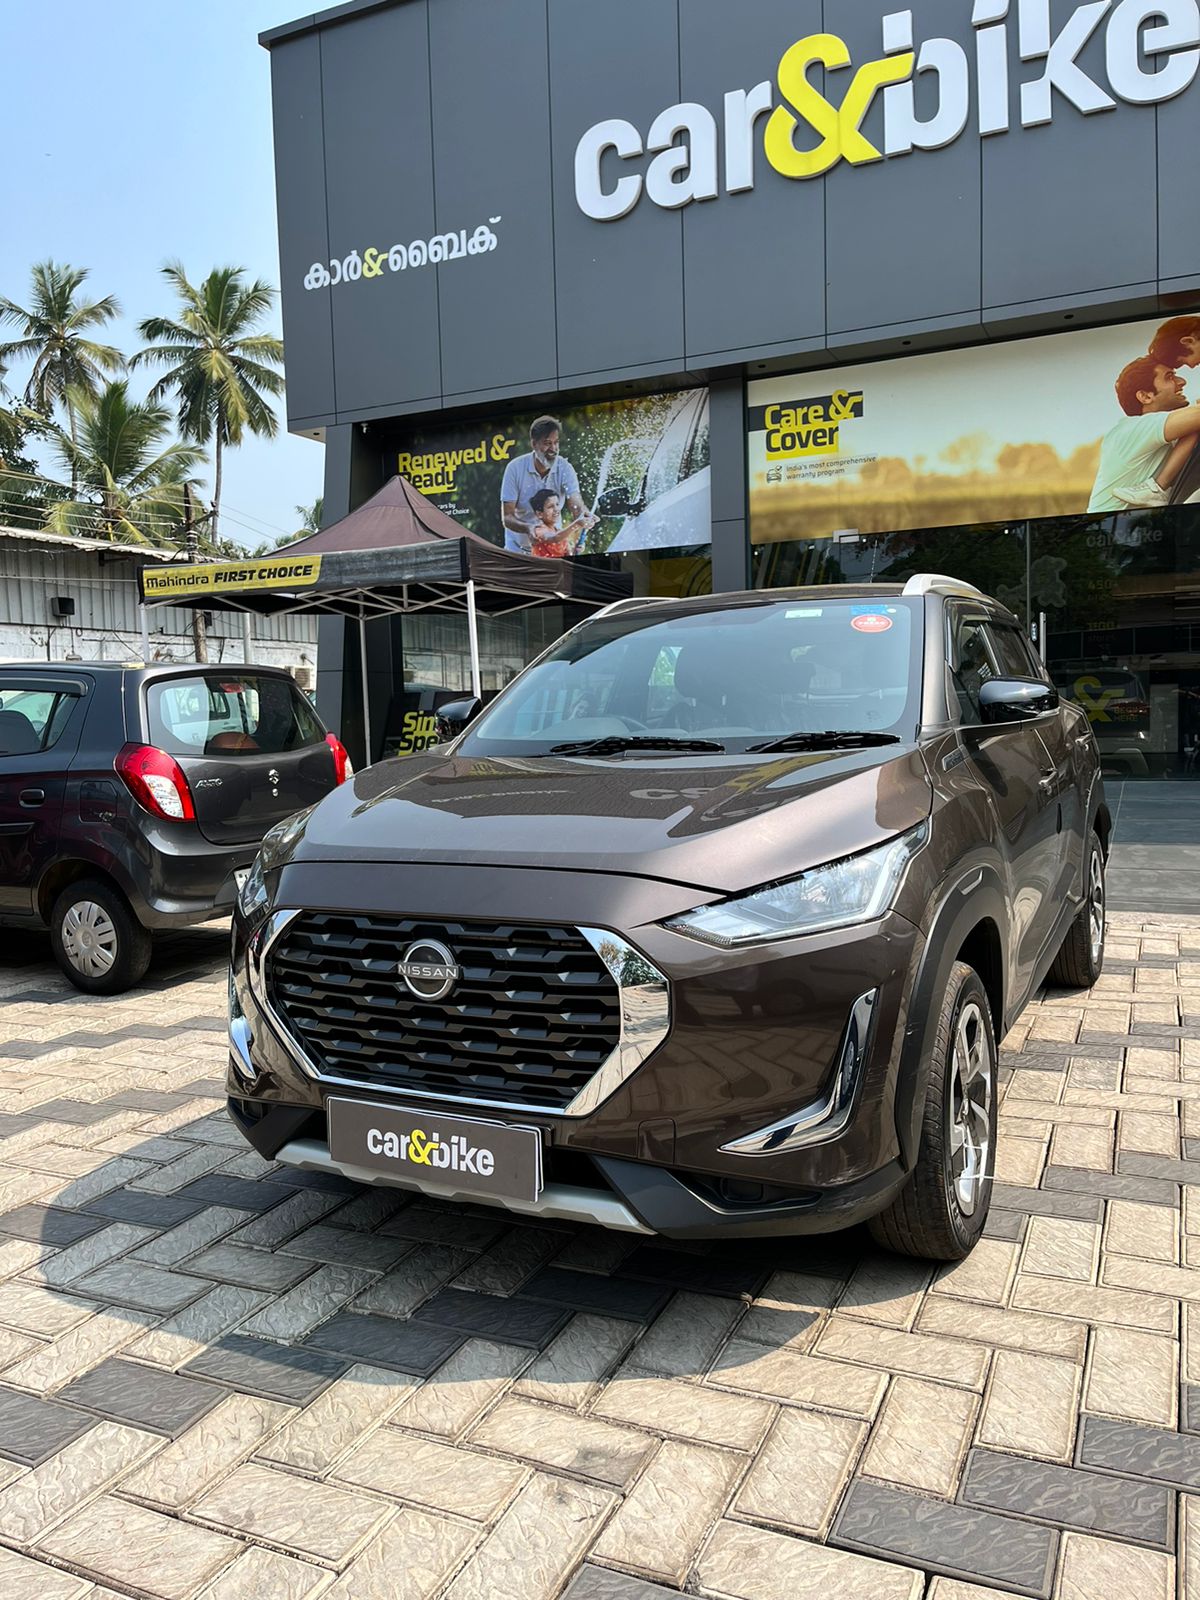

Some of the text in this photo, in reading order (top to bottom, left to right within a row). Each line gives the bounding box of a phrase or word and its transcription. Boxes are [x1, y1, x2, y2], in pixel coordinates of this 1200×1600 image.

[574, 0, 1200, 221] car&bike
[303, 215, 502, 290] കാർ&ബൈക്
[765, 388, 864, 429] Care &
[398, 434, 515, 472] Renewed &
[765, 425, 839, 452] Cover
[786, 468, 845, 480] warranty program
[808, 461, 825, 469] most
[826, 456, 877, 468] comprehensive
[214, 569, 257, 583] FIRST
[258, 564, 314, 580] CHOICE
[398, 963, 457, 978] NISSAN
[366, 1127, 496, 1177] car&bike
